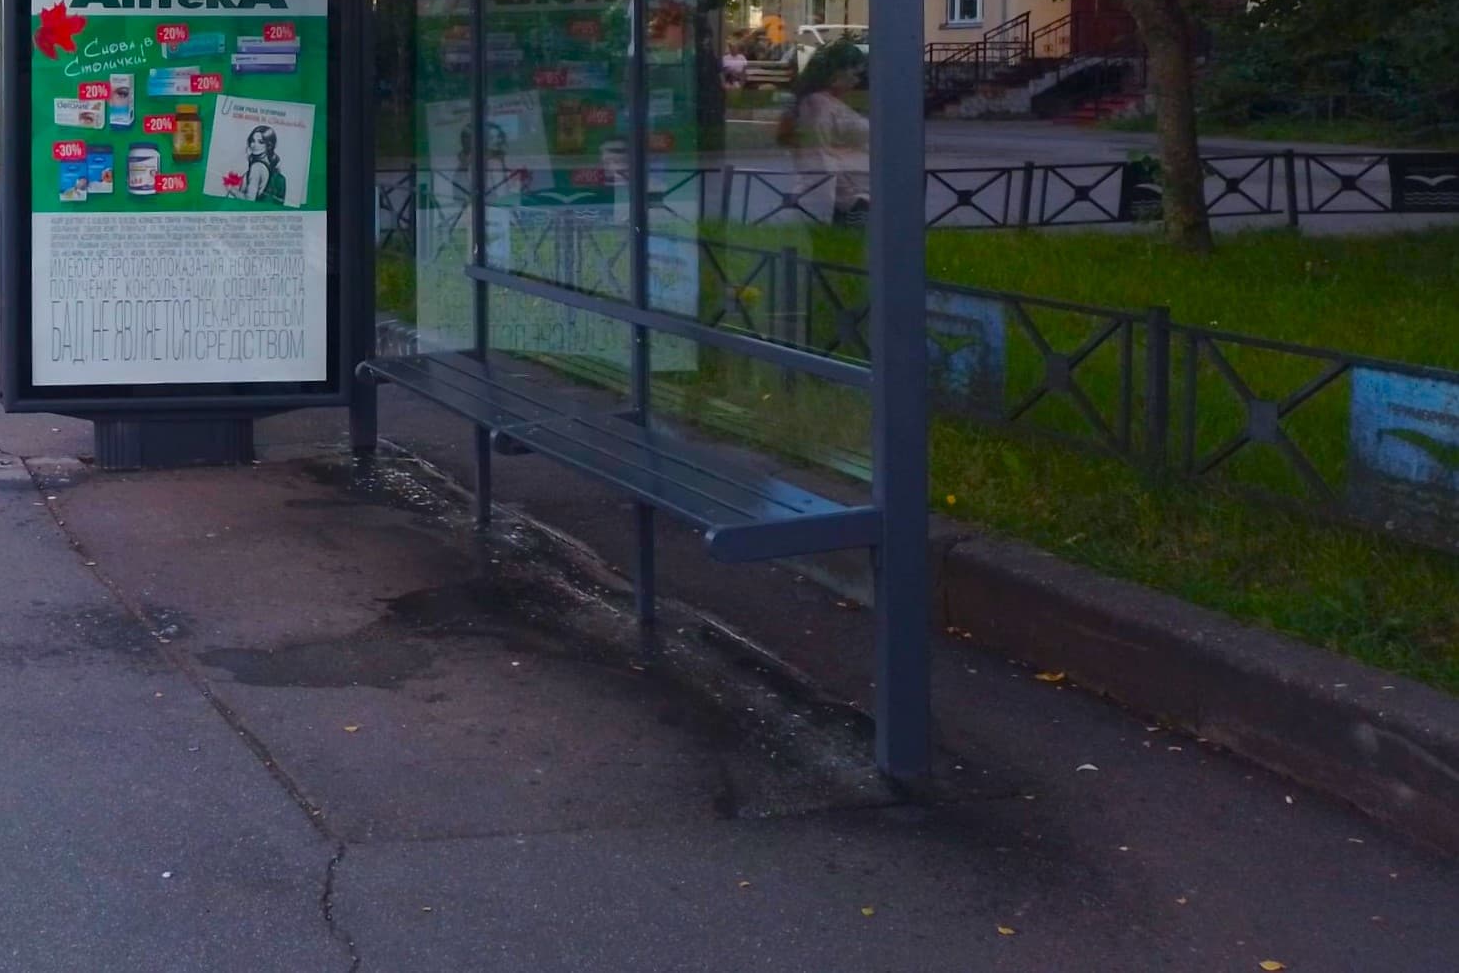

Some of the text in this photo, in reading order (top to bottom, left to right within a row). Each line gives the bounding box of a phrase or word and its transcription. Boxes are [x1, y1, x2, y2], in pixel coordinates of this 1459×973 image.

[158, 26, 186, 41] -20%
[265, 25, 293, 39] -20%
[192, 76, 220, 91] -20%
[81, 84, 109, 99] -20%
[145, 117, 173, 131] -20%
[54, 143, 83, 158] -30%
[156, 176, 185, 191] -20%
[49, 257, 105, 278] ИМЕЮТСЯ
[49, 278, 118, 300] ПОЛУЧЕНИЕ
[193, 298, 305, 328] ЛЕКАРСТВЕННЫМ
[91, 300, 110, 363] НЕ
[113, 299, 191, 362] ЯВЛЯЕТСЯ
[194, 329, 305, 364] СРЕДСТВОМ
